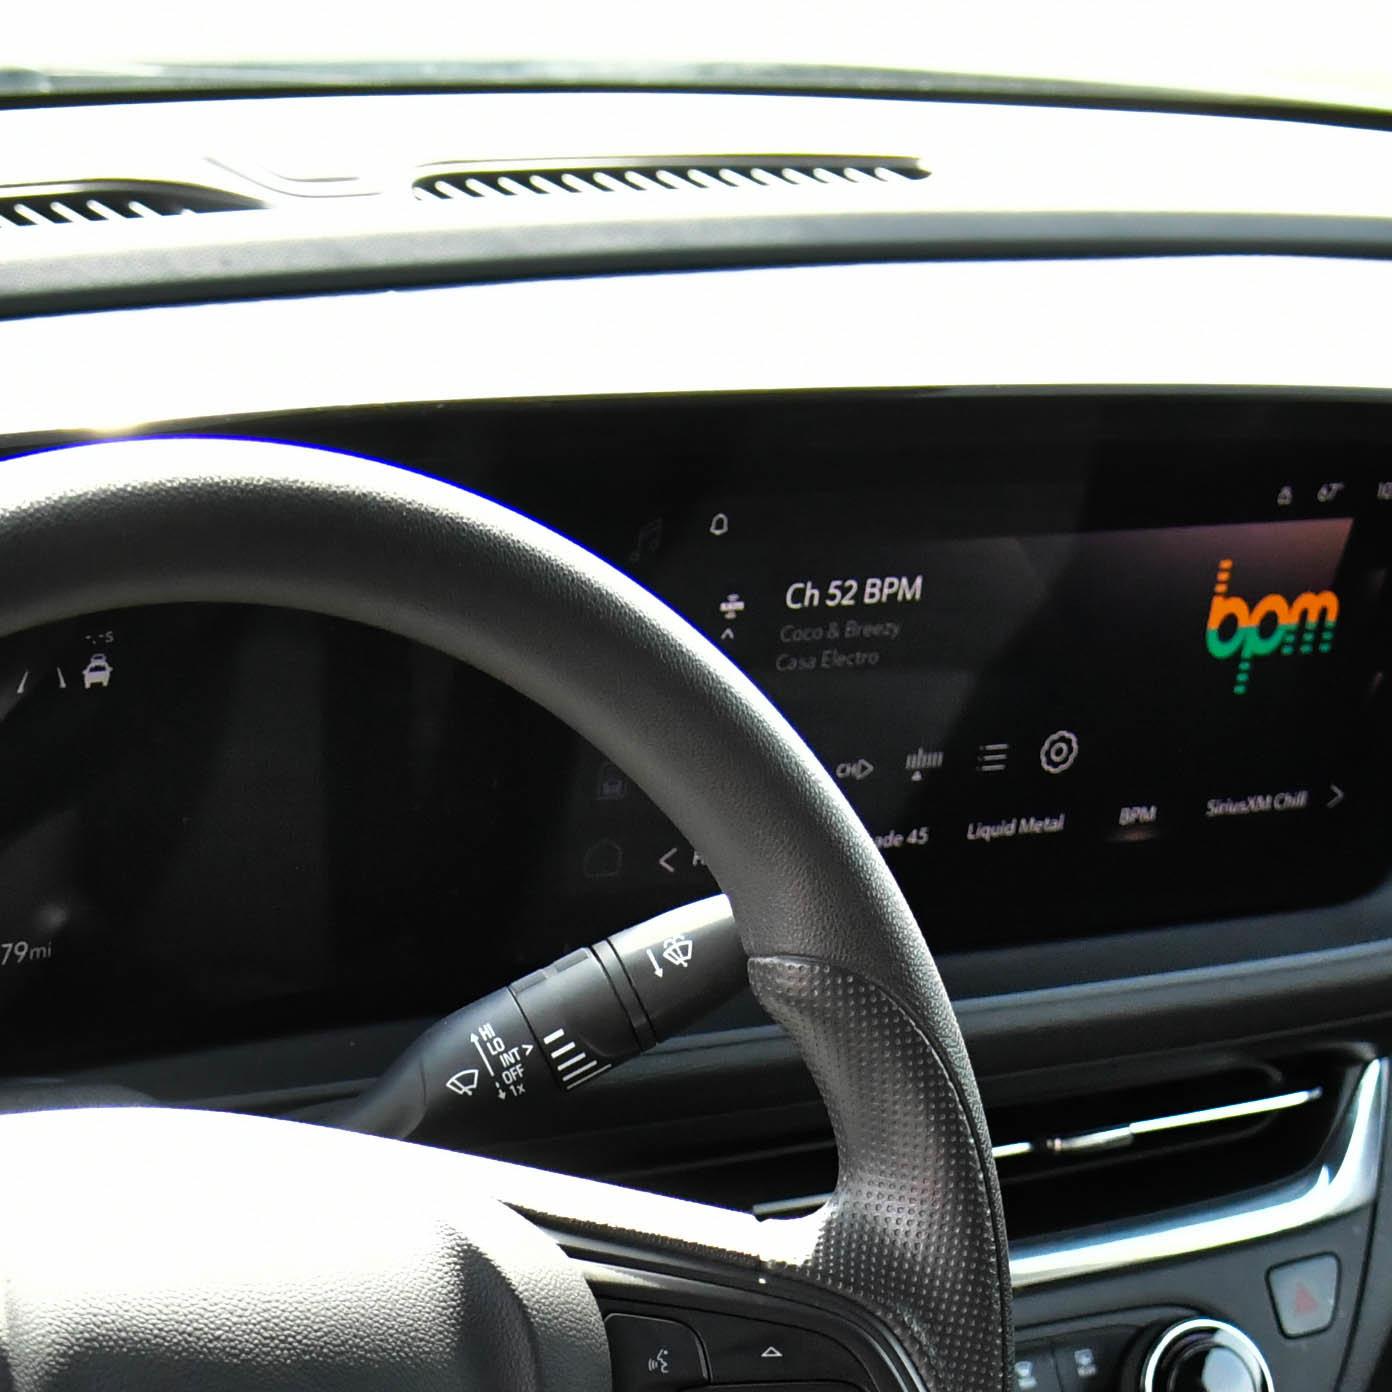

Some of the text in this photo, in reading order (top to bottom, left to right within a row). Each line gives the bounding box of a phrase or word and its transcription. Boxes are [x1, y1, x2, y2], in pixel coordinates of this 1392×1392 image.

[786, 574, 924, 609] Ch 52 BPM
[780, 619, 901, 643] Coco & Breezy
[1206, 558, 1340, 695] bpm
[776, 648, 880, 672] Casa Electro
[1206, 790, 1309, 817] SiriusXM Chill
[1119, 805, 1158, 825] BPM
[907, 826, 929, 846] 45
[967, 813, 1066, 841] Liquid Metal
[478, 1022, 496, 1041] HI
[486, 1037, 506, 1056] LO
[499, 1046, 521, 1068] INT
[502, 1063, 524, 1084] OFF
[509, 1083, 526, 1097] 1x
